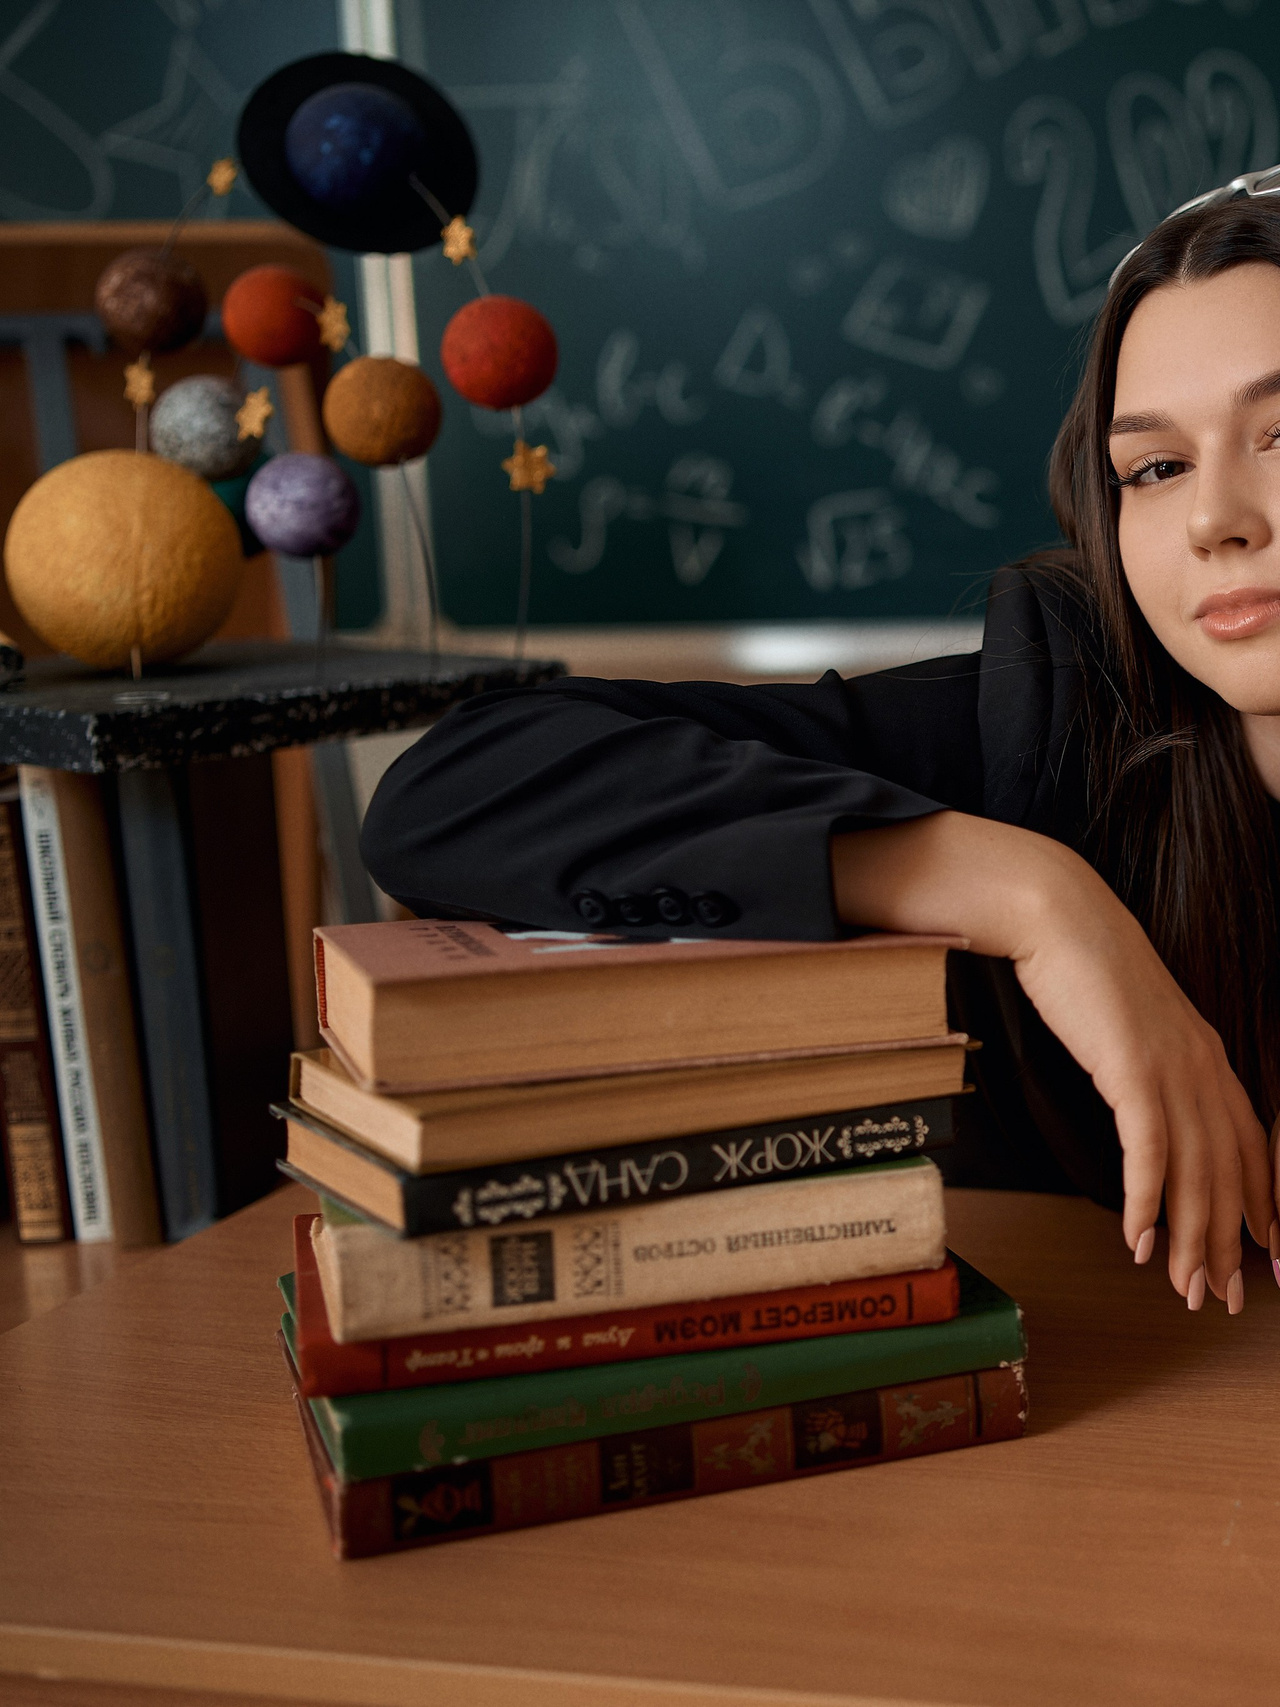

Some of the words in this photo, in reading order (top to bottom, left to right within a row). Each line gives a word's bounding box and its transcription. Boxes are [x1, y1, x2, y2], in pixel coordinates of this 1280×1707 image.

[711, 1125, 837, 1183] ЖОРЖ
[563, 1149, 689, 1206] САНД
[634, 1236, 717, 1263] ОСТРОВ
[725, 1217, 897, 1255] ТАИНСТВЕННЫЙ
[653, 1310, 742, 1344] МОЭМ
[750, 1294, 897, 1333] СОМЕРСЕТ
